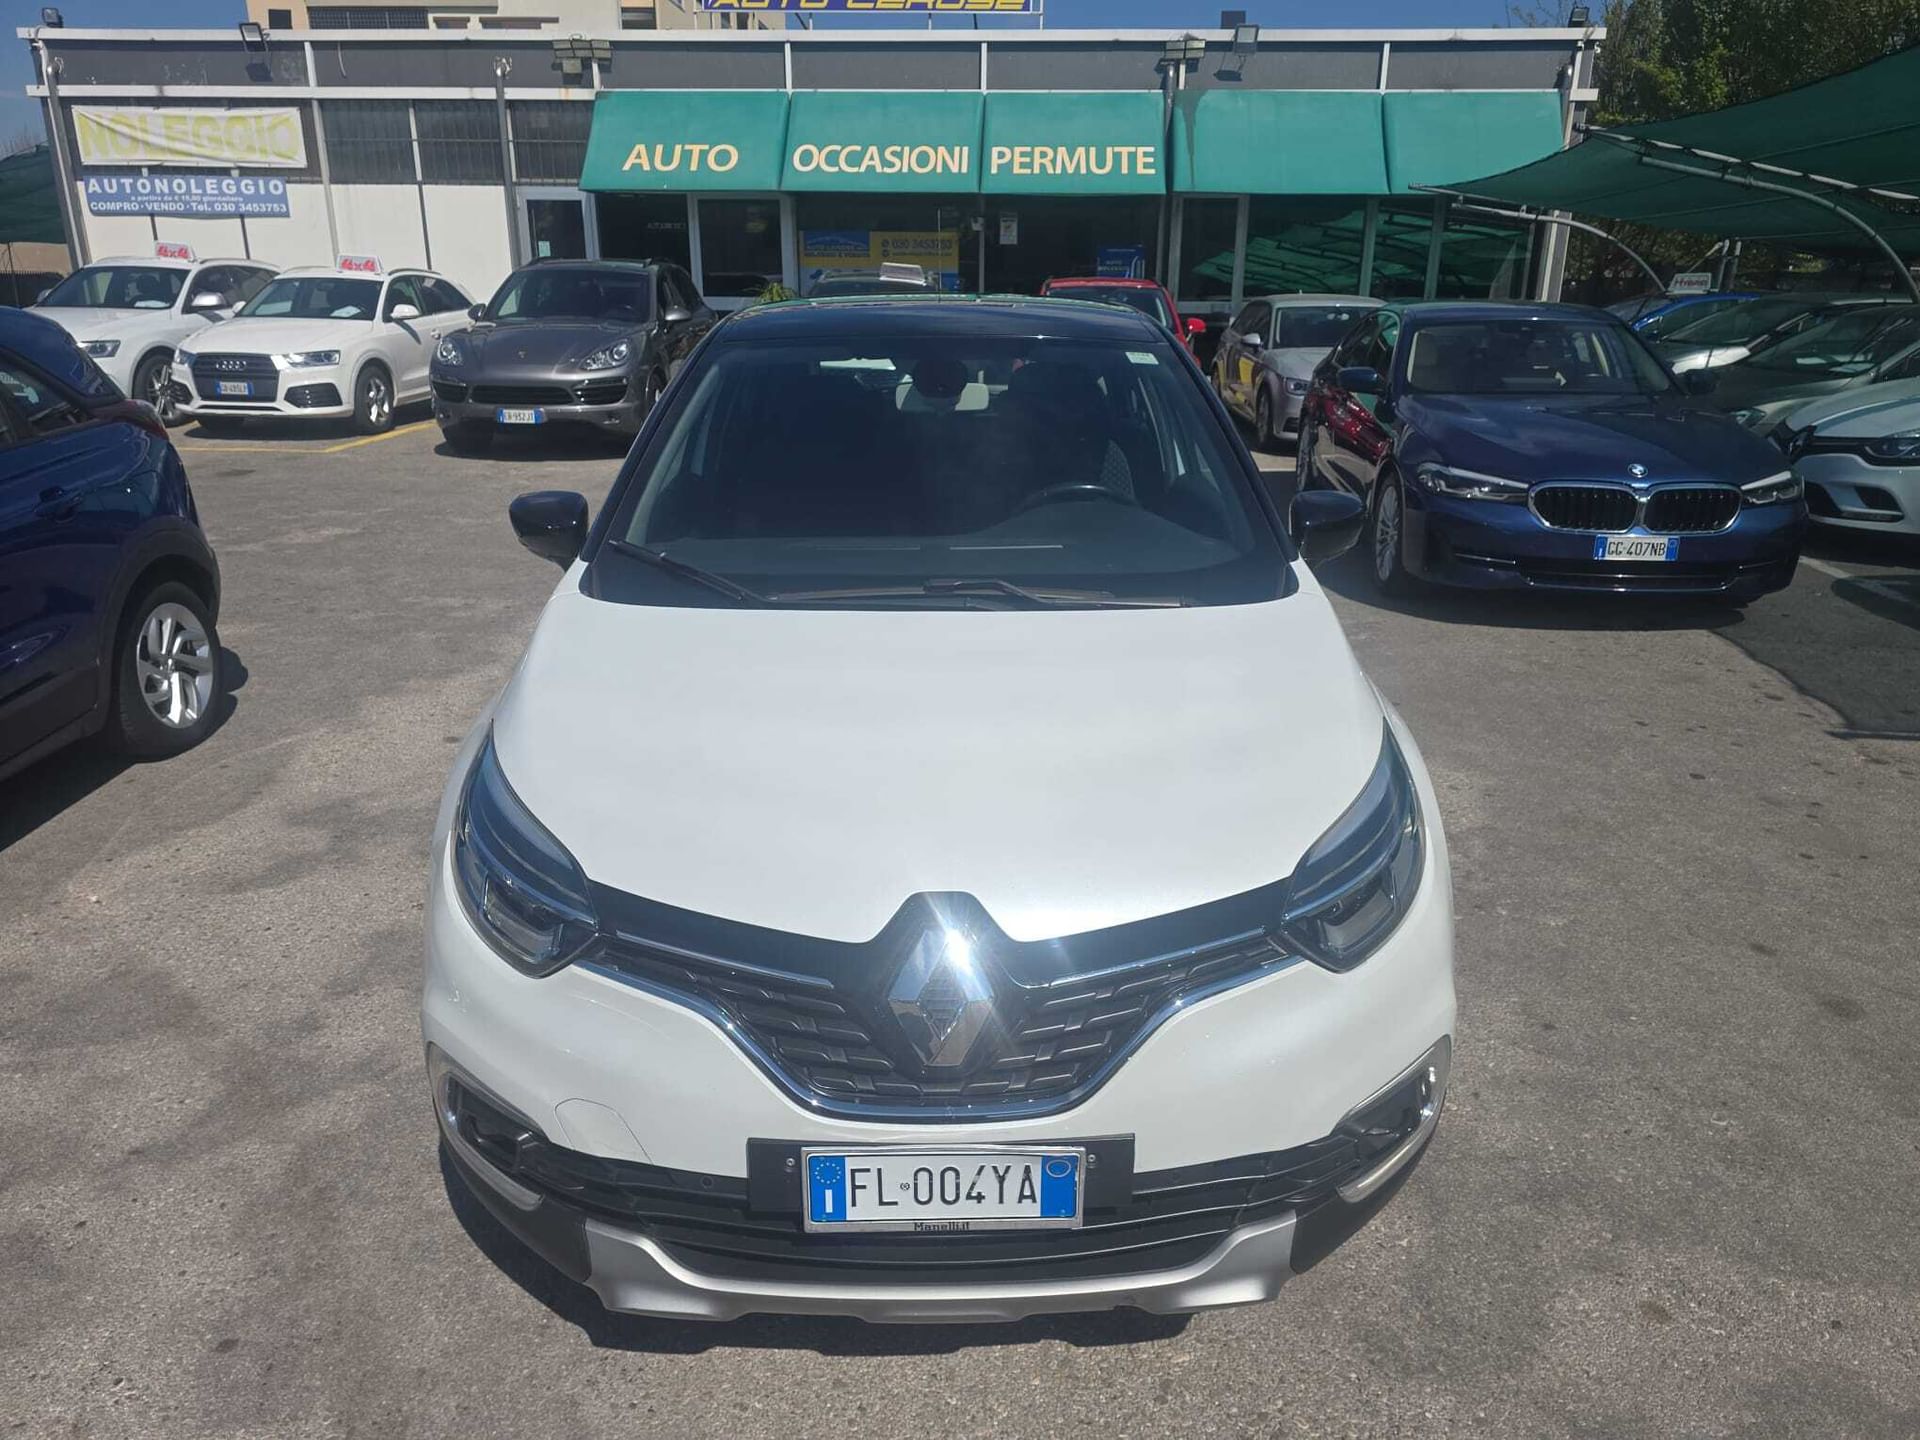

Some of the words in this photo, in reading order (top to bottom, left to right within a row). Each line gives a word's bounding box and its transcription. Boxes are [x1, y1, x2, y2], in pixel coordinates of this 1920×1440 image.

[77, 111, 300, 161] NOLEGGIO
[622, 144, 739, 172] AUTO
[792, 144, 969, 174] OCCASIONI
[990, 146, 1156, 175] PERMUTE
[88, 178, 284, 195] AUTONOLEGGIO
[90, 201, 139, 211] COMPRO
[145, 202, 185, 211] VENDO
[191, 202, 211, 211] Tel.
[214, 203, 235, 211] 030
